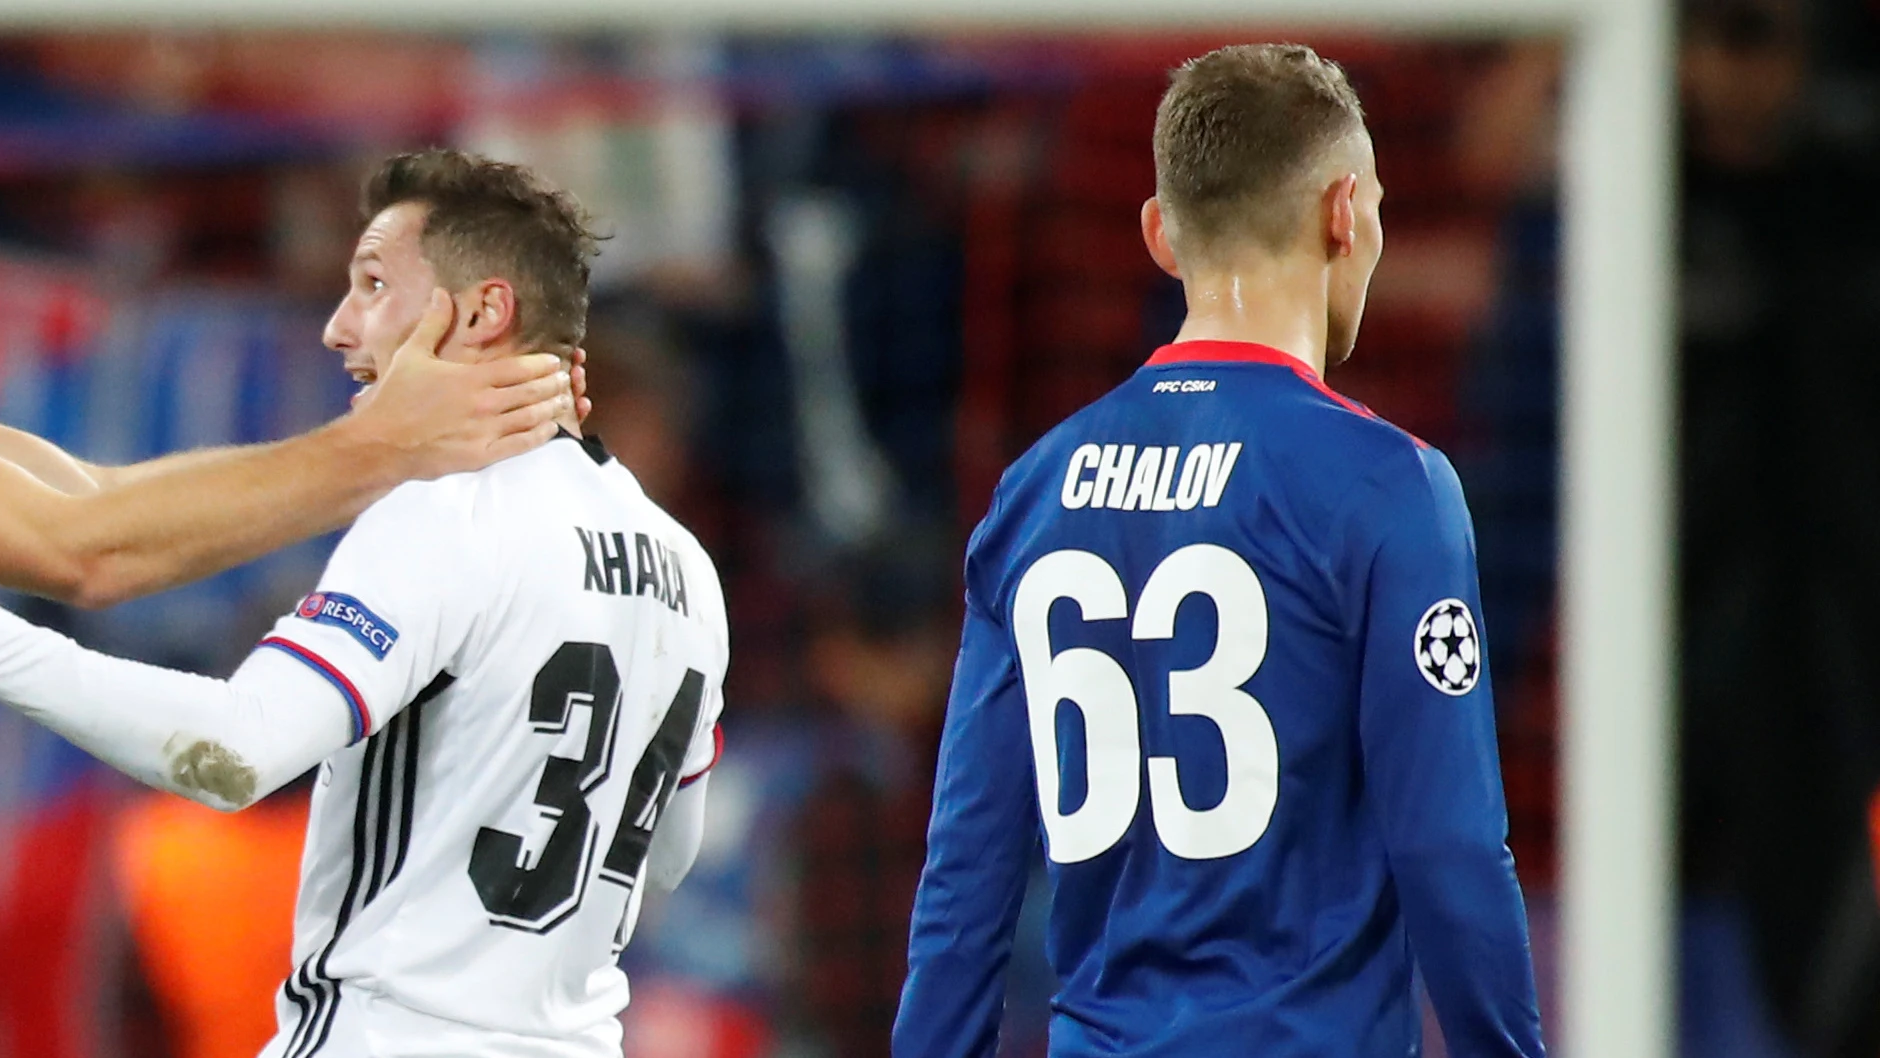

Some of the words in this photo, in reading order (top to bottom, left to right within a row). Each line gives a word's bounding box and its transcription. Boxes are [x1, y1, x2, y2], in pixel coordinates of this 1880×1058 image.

[1152, 380, 1181, 393] PFC
[1180, 379, 1217, 392] CSKA
[1061, 442, 1242, 512] CHALOV
[321, 600, 394, 652] RESPECT
[1013, 543, 1280, 864] 63
[467, 640, 708, 957] 34
